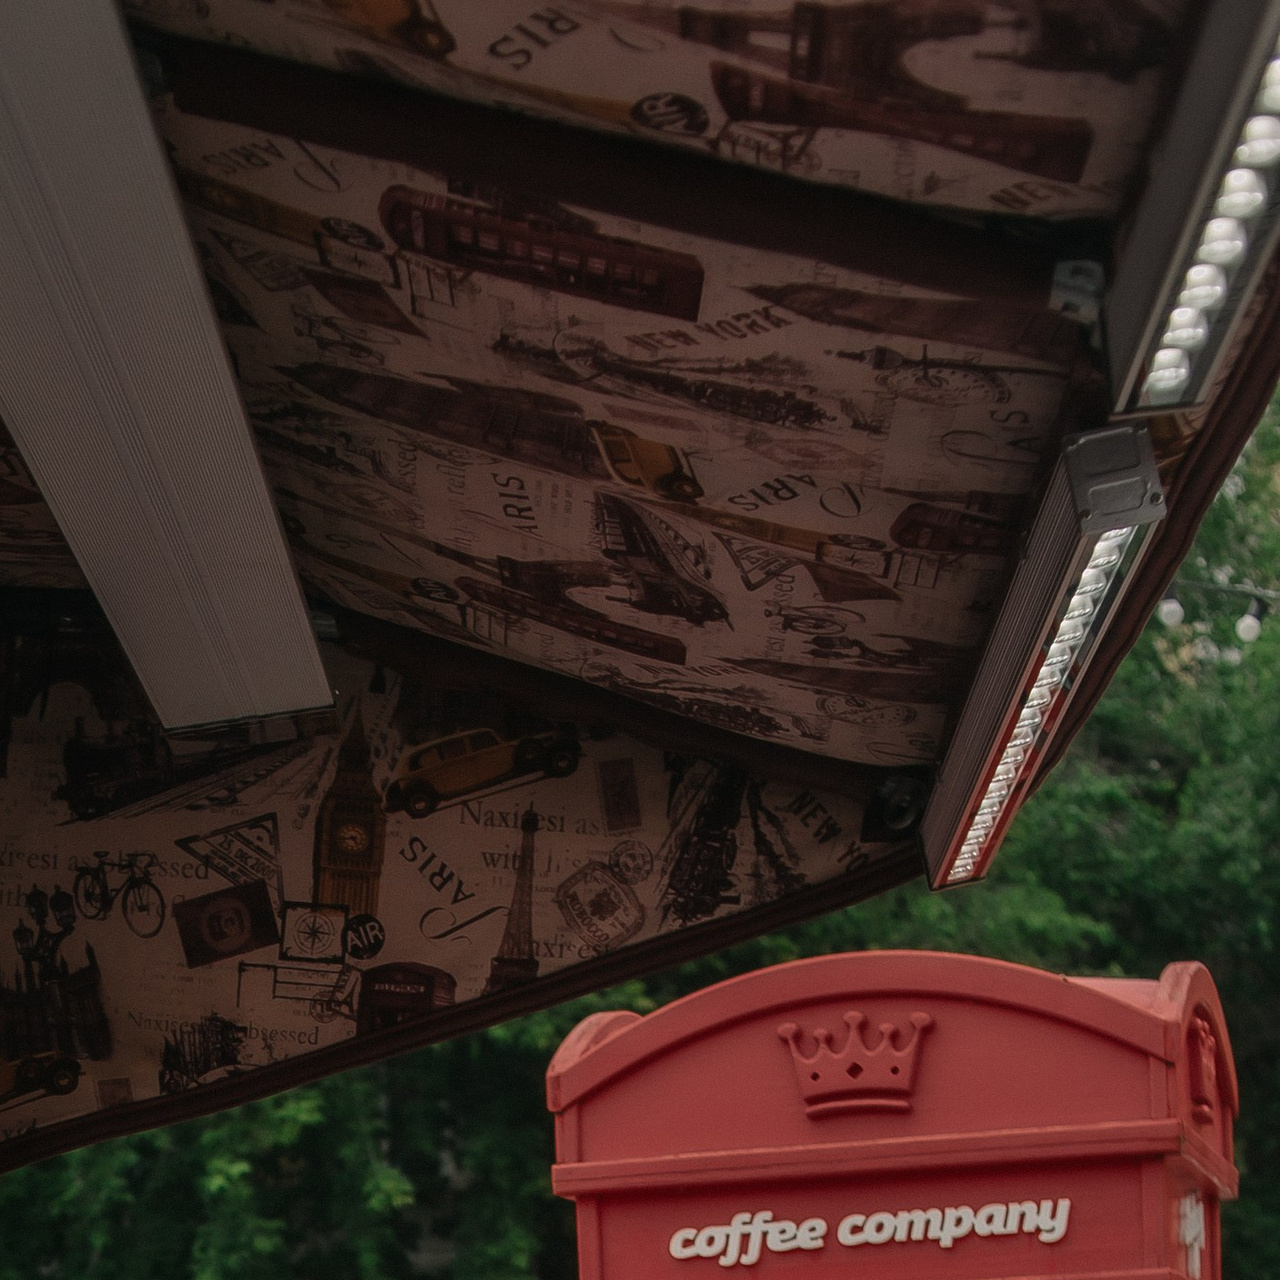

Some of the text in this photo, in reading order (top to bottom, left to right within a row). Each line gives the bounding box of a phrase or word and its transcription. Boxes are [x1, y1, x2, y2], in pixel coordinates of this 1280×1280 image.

[344, 922, 384, 949] AIR
[669, 1197, 1071, 1266] coffee company
